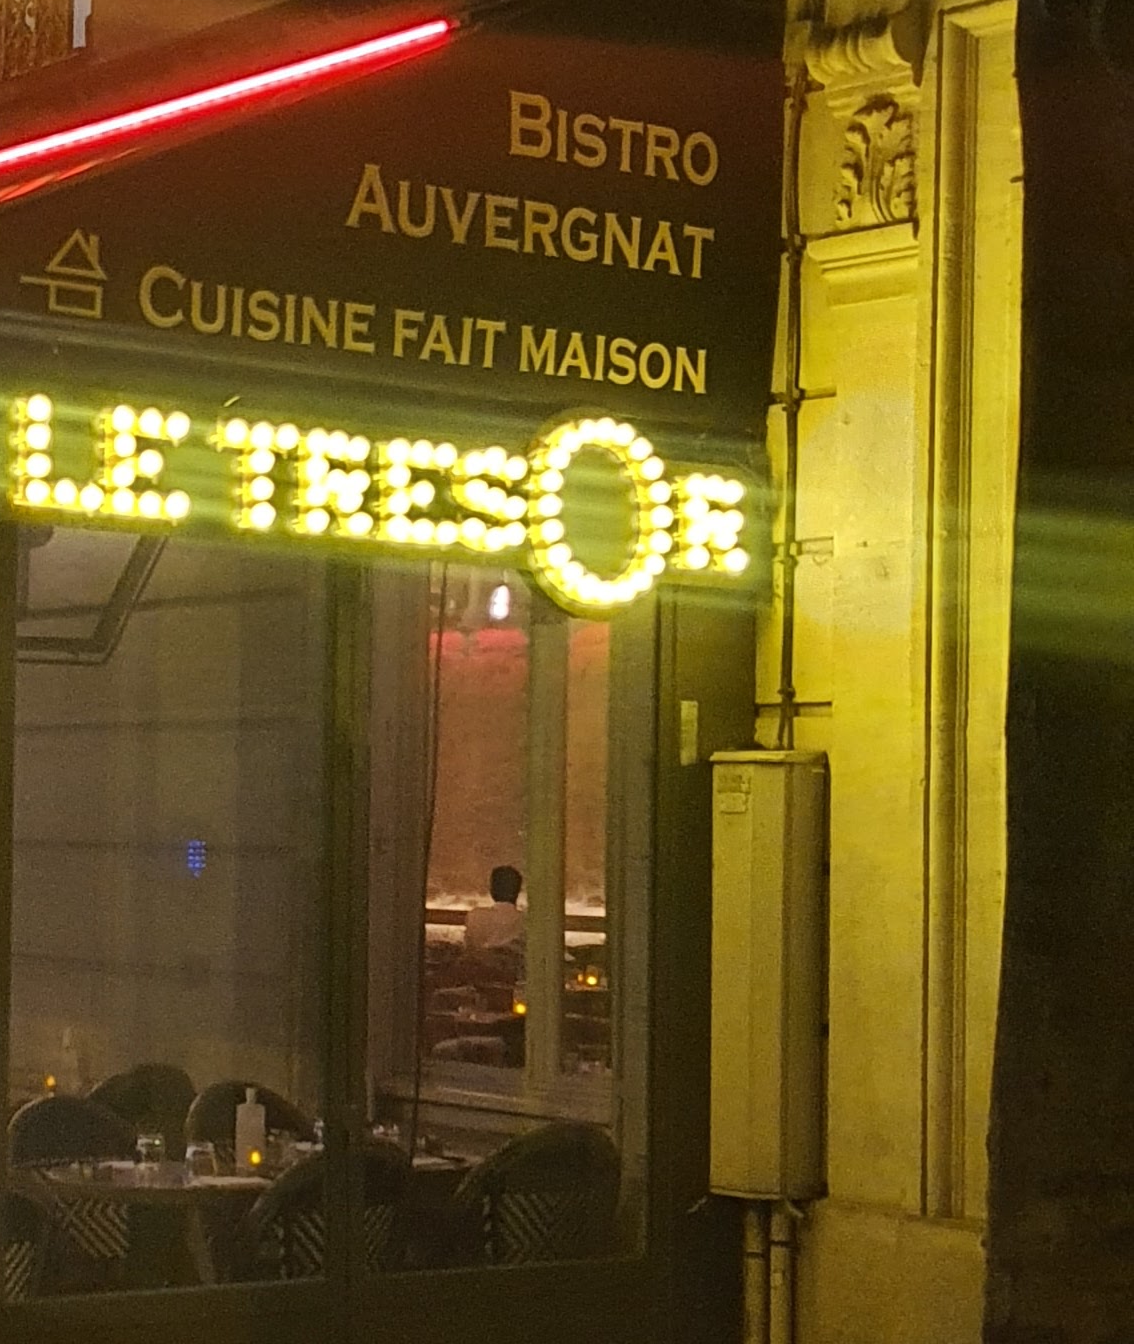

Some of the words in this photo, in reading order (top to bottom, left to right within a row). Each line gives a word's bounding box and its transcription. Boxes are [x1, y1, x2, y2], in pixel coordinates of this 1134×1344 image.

[508, 90, 719, 186] BISTRO
[345, 163, 714, 280] AUVERGNAT
[138, 265, 377, 354] CUISINE
[393, 309, 506, 369] FAIT
[518, 325, 707, 395] MAISON
[11, 392, 191, 521] LE
[212, 413, 749, 614] TRESOR
